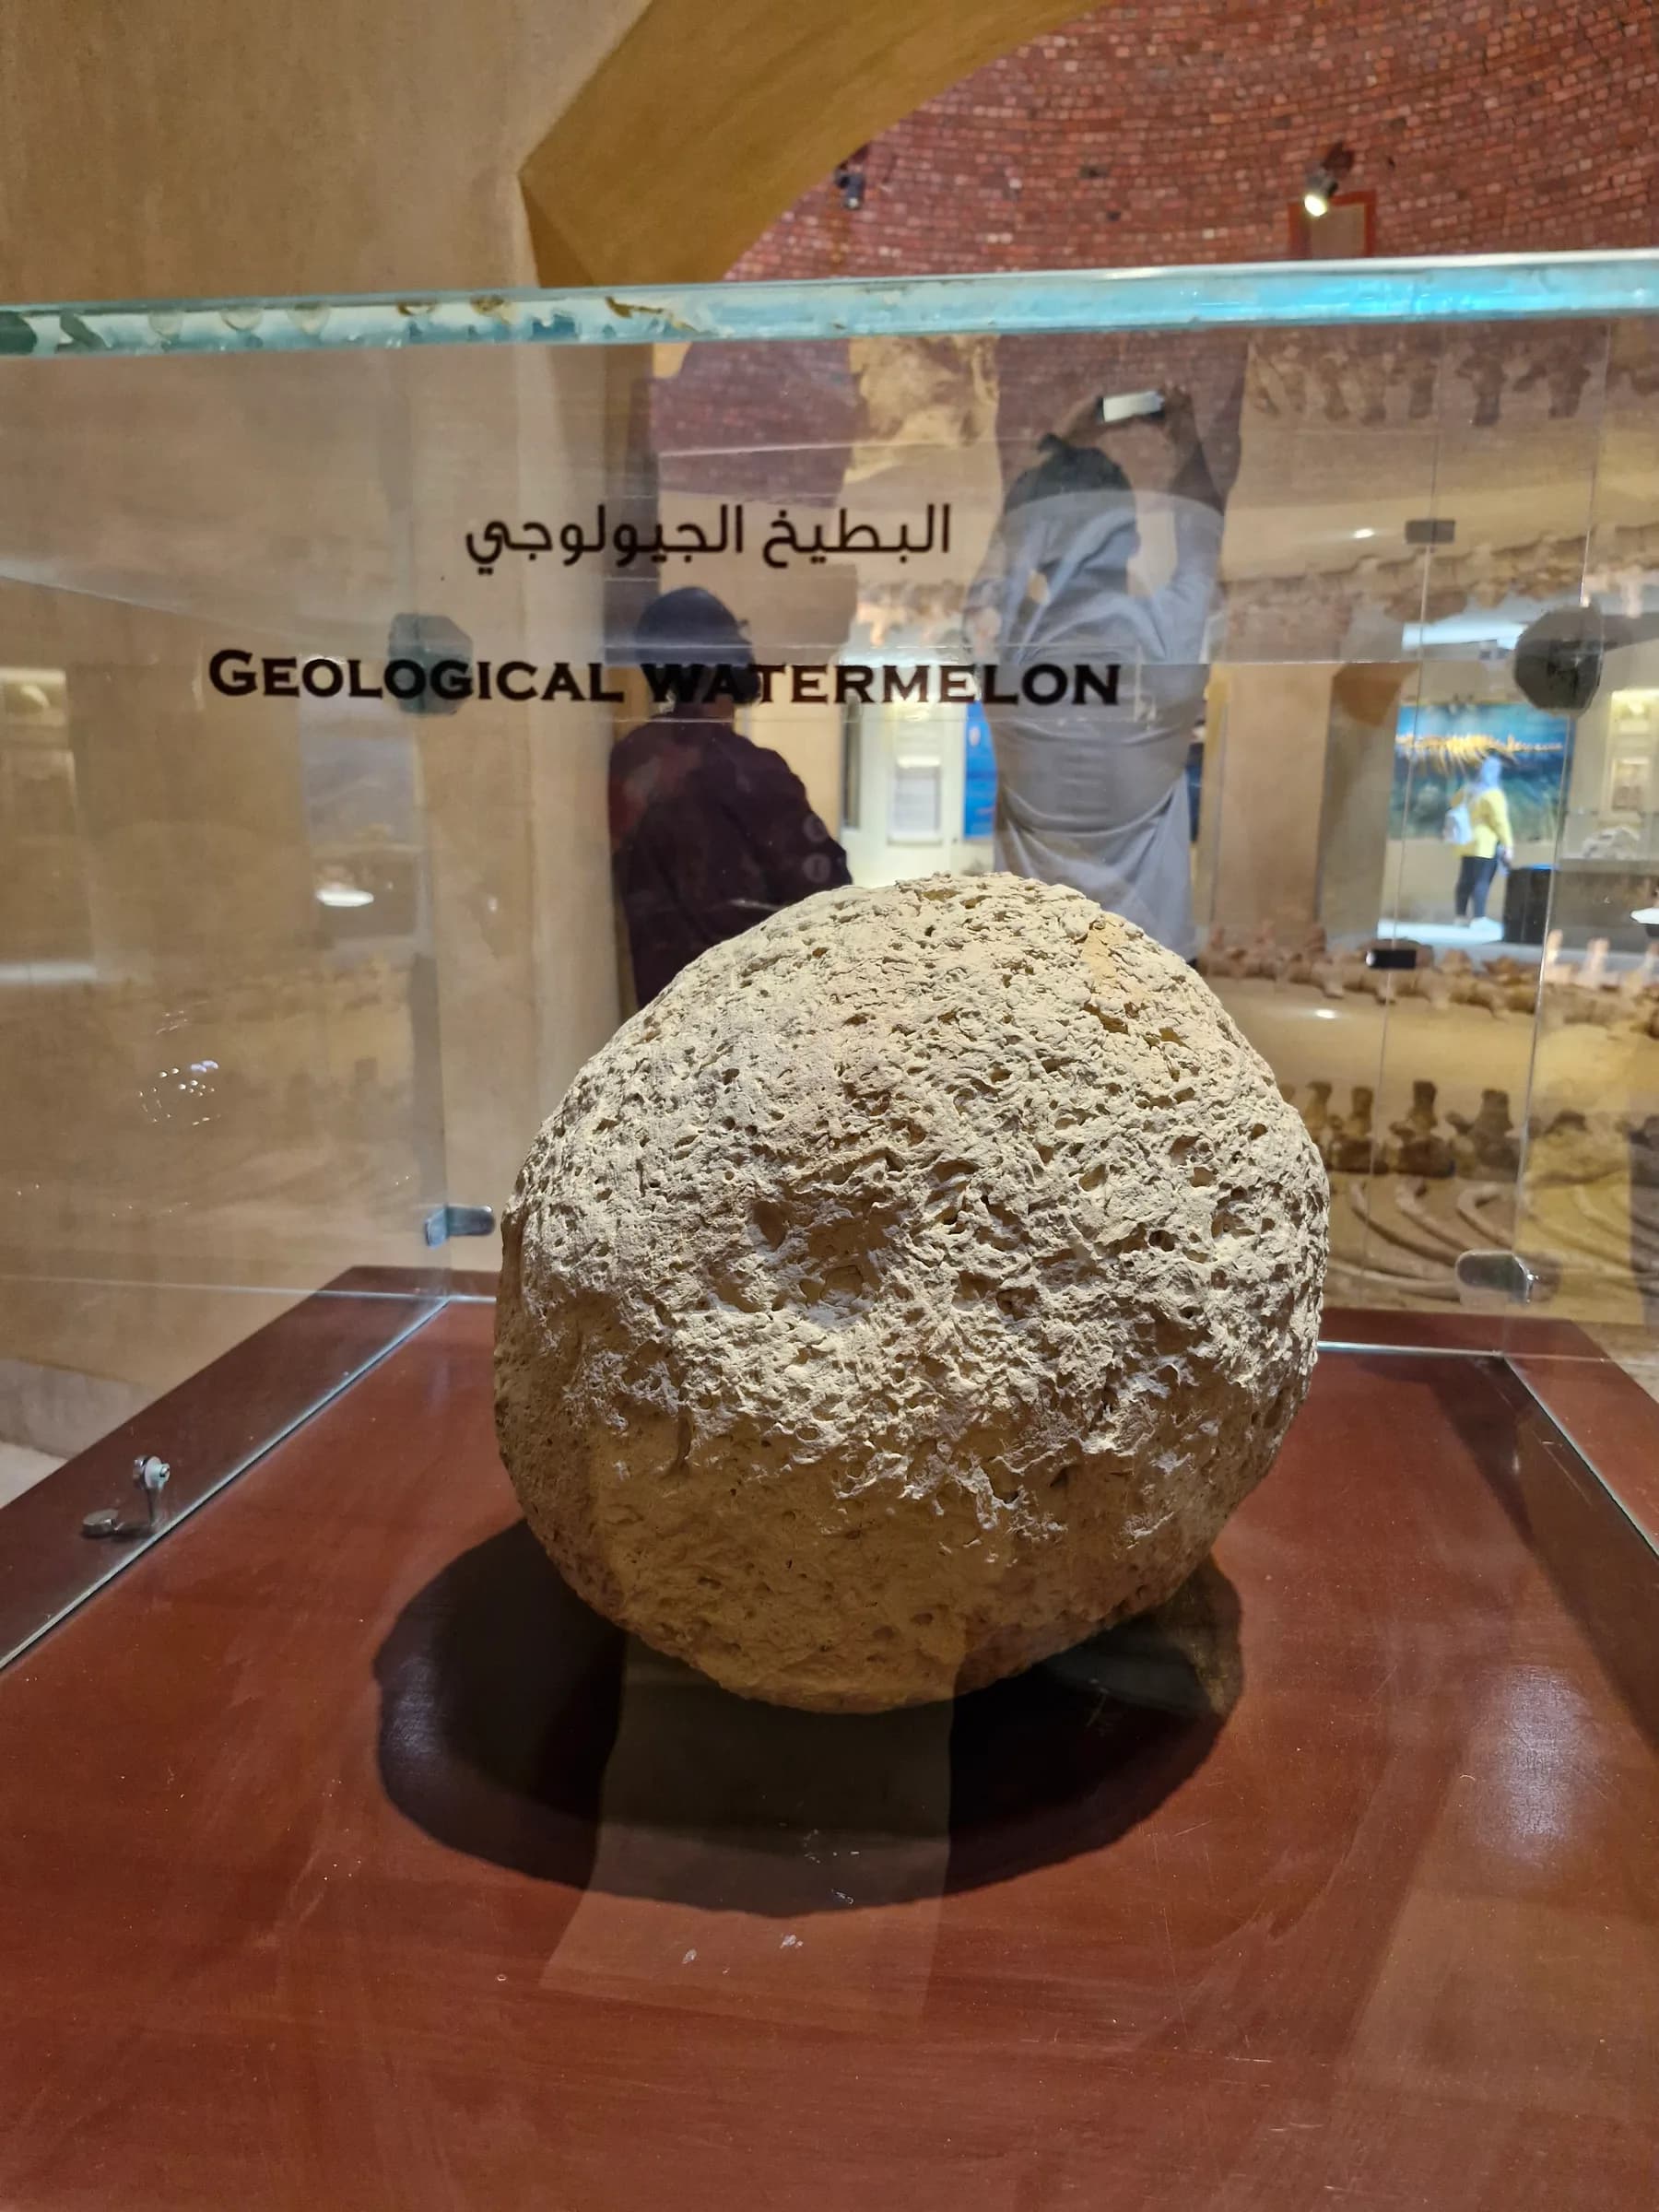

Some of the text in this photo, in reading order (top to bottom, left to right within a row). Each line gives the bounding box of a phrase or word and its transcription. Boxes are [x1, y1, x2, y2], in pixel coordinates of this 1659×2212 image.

[465, 503, 951, 575] البطيخ الجيولوجي
[208, 649, 1121, 705] GEOLOGICAL WATERMELON
